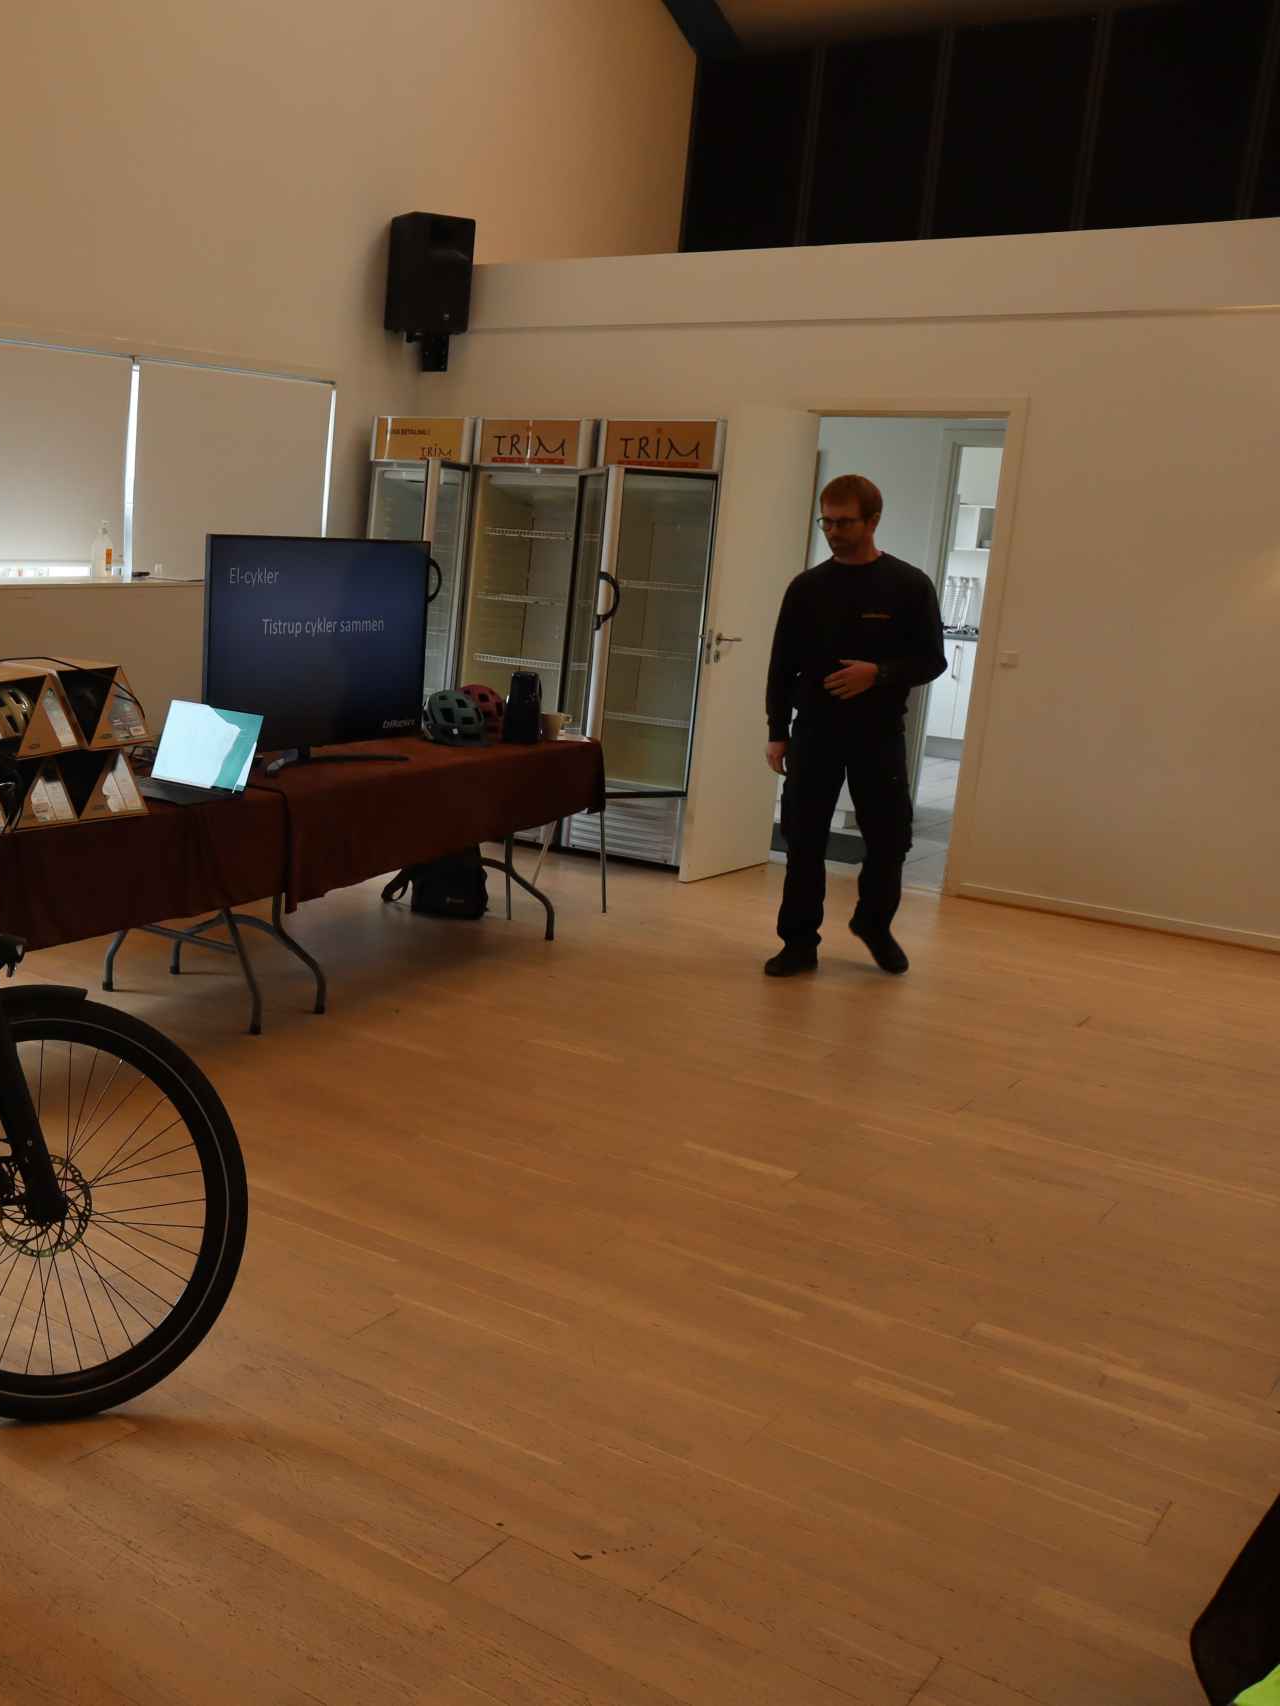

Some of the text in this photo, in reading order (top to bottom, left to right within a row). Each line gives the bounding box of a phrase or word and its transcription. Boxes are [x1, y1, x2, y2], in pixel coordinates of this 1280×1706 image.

[492, 428, 566, 456] TRIM
[619, 428, 700, 460] TRIM
[228, 567, 280, 586] El-cykler
[262, 617, 385, 637] Tistrup cykler sammen
